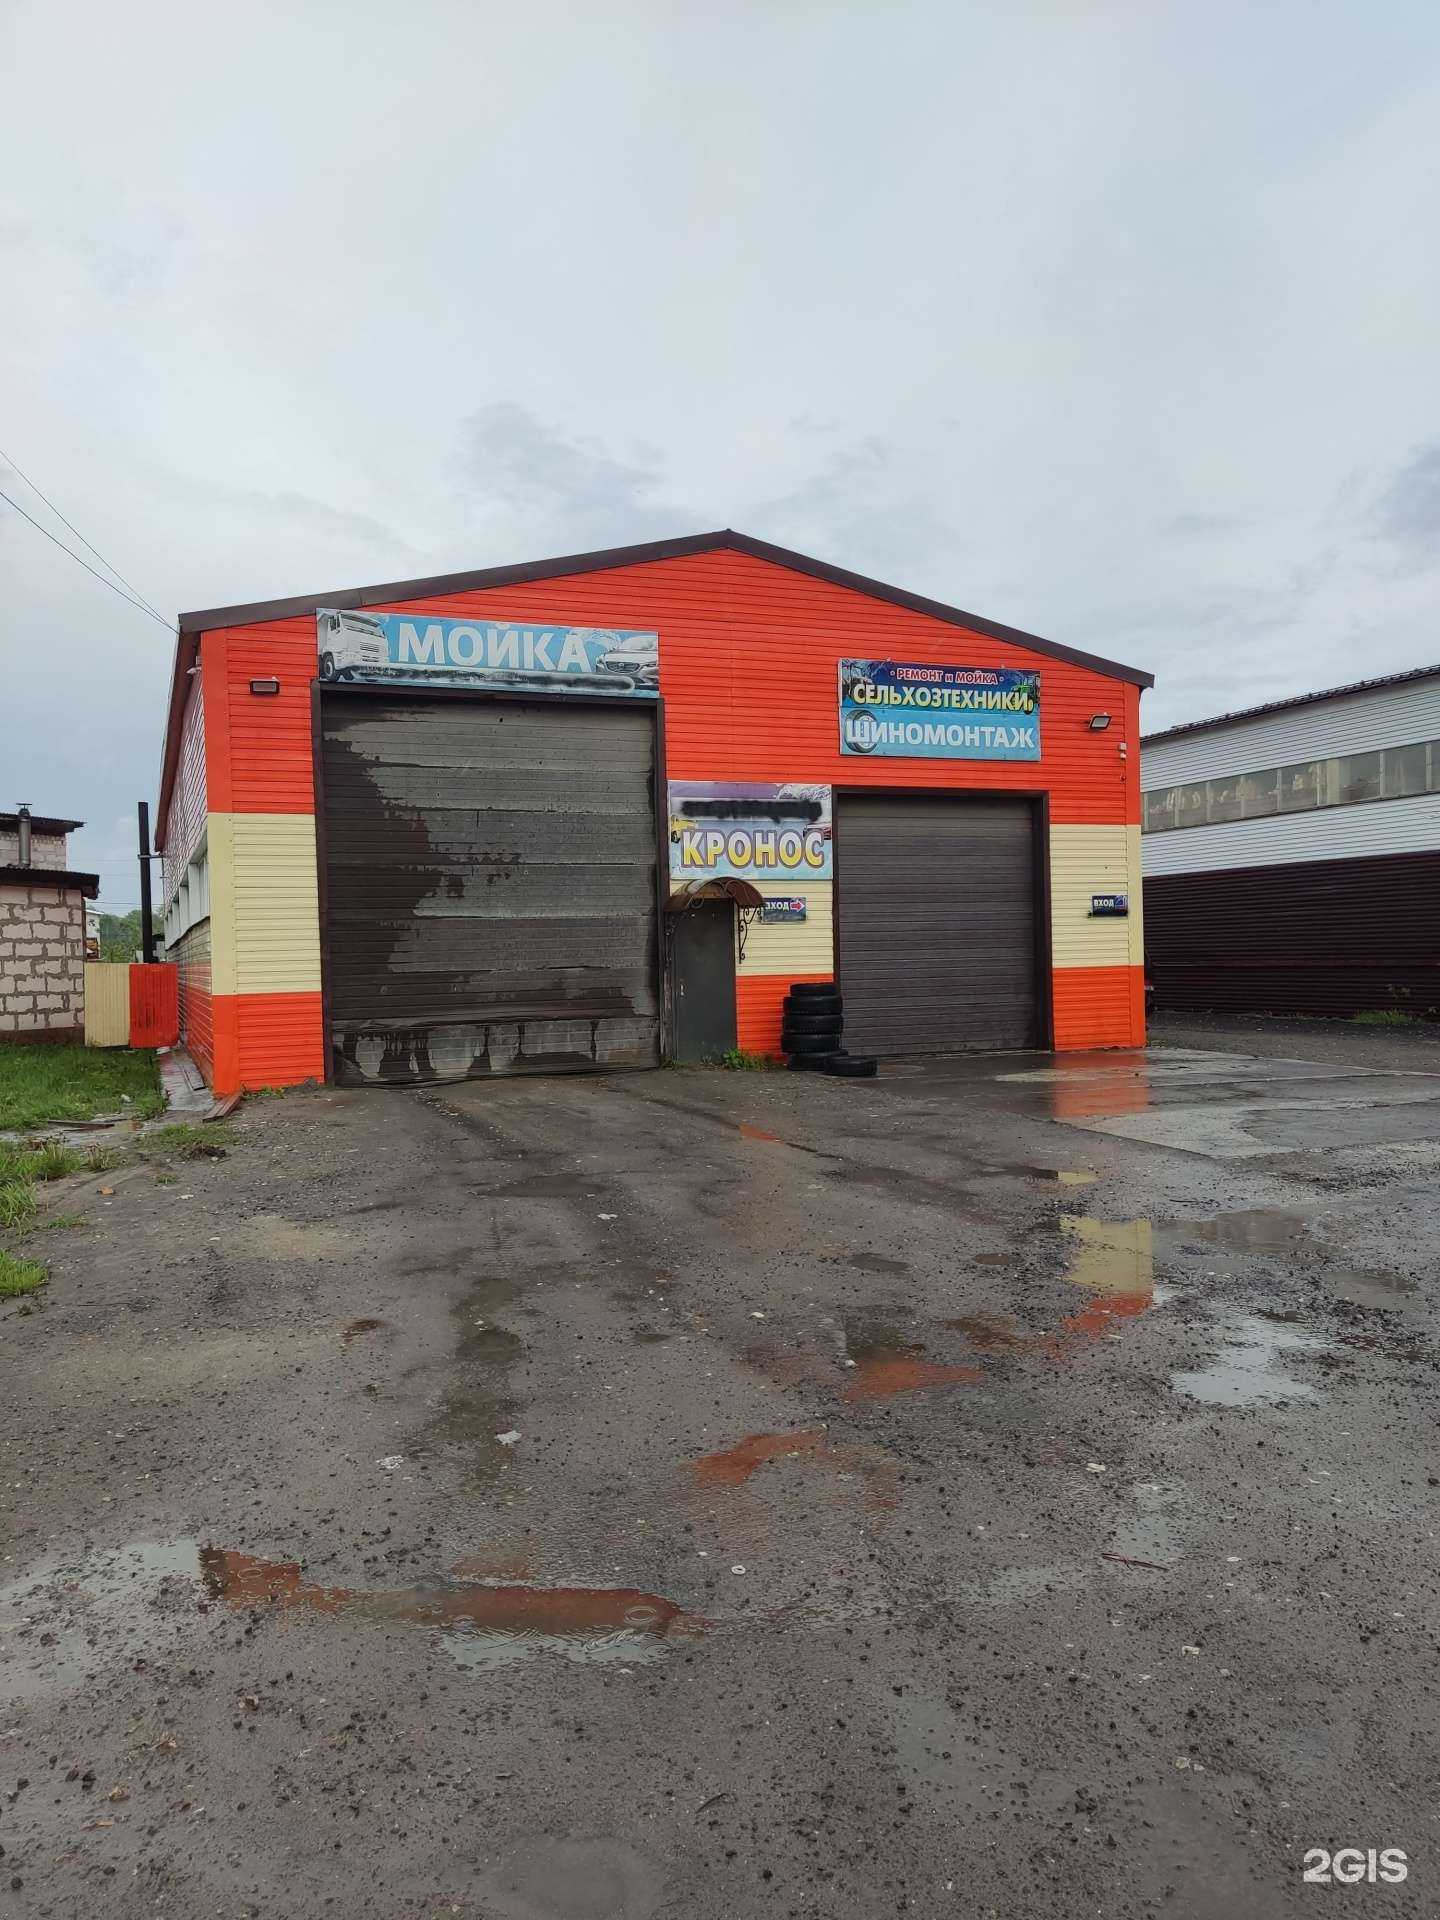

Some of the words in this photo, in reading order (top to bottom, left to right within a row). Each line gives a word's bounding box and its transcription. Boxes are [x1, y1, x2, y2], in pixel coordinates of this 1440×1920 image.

[398, 622, 592, 673] МОЙКА
[897, 668, 943, 682] РЕМОНТ
[955, 671, 998, 685] МОЙКА
[846, 718, 1035, 748] ШИНОМОНТАЖ
[681, 829, 825, 868] КРОНОС
[1093, 899, 1114, 907] ВХОД
